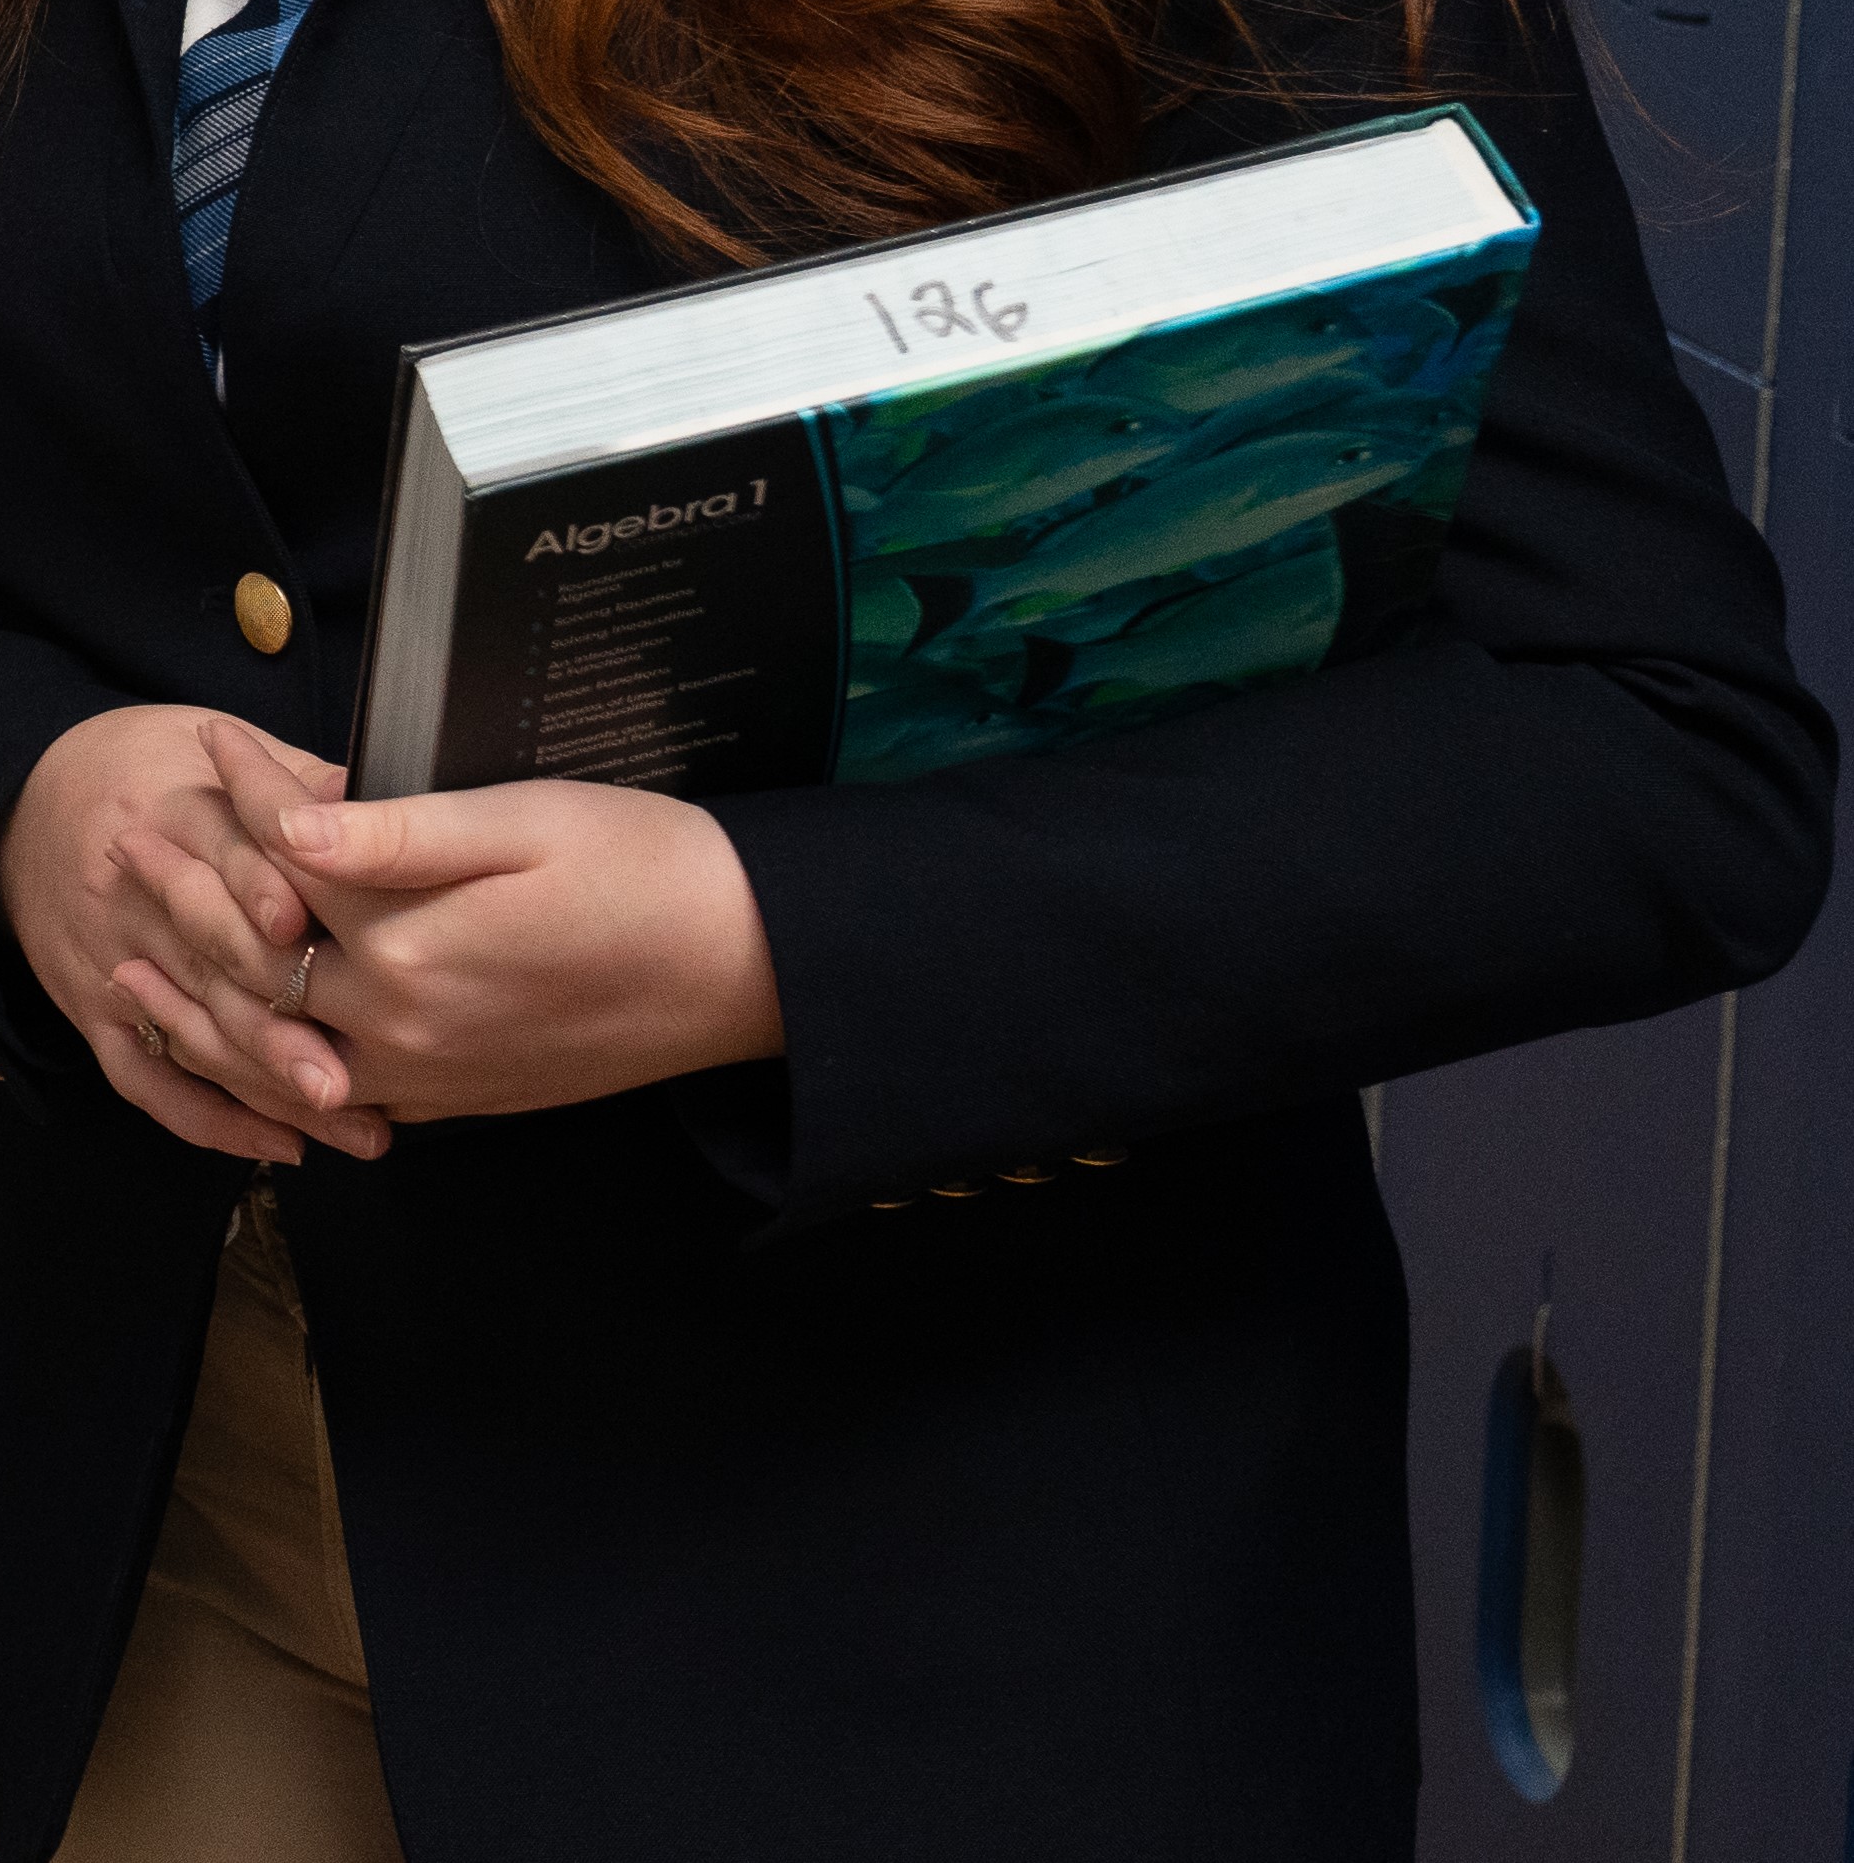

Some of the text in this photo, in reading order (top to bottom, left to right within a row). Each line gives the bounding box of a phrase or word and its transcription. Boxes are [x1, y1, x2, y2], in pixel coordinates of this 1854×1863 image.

[864, 280, 1029, 353] 126
[523, 478, 769, 563] Algebra 1
[558, 565, 658, 593] Foundations
[662, 558, 683, 568] for
[553, 607, 611, 627] Solving
[615, 588, 695, 613] Equations
[557, 583, 622, 605] Algebra
[551, 607, 705, 649] Solving Inequalities
[566, 653, 642, 675] Functions
[541, 667, 757, 723] Systems of Linear Equations
[543, 684, 591, 702] Linear
[596, 667, 671, 689] Functions
[539, 719, 571, 734] and
[576, 698, 666, 725] Inequalities
[535, 737, 628, 765] Exponential
[631, 719, 706, 743] Functions
[536, 730, 617, 754] Exponents
[621, 719, 655, 735] and
[628, 748, 663, 763] and
[664, 731, 739, 754] Factoring
